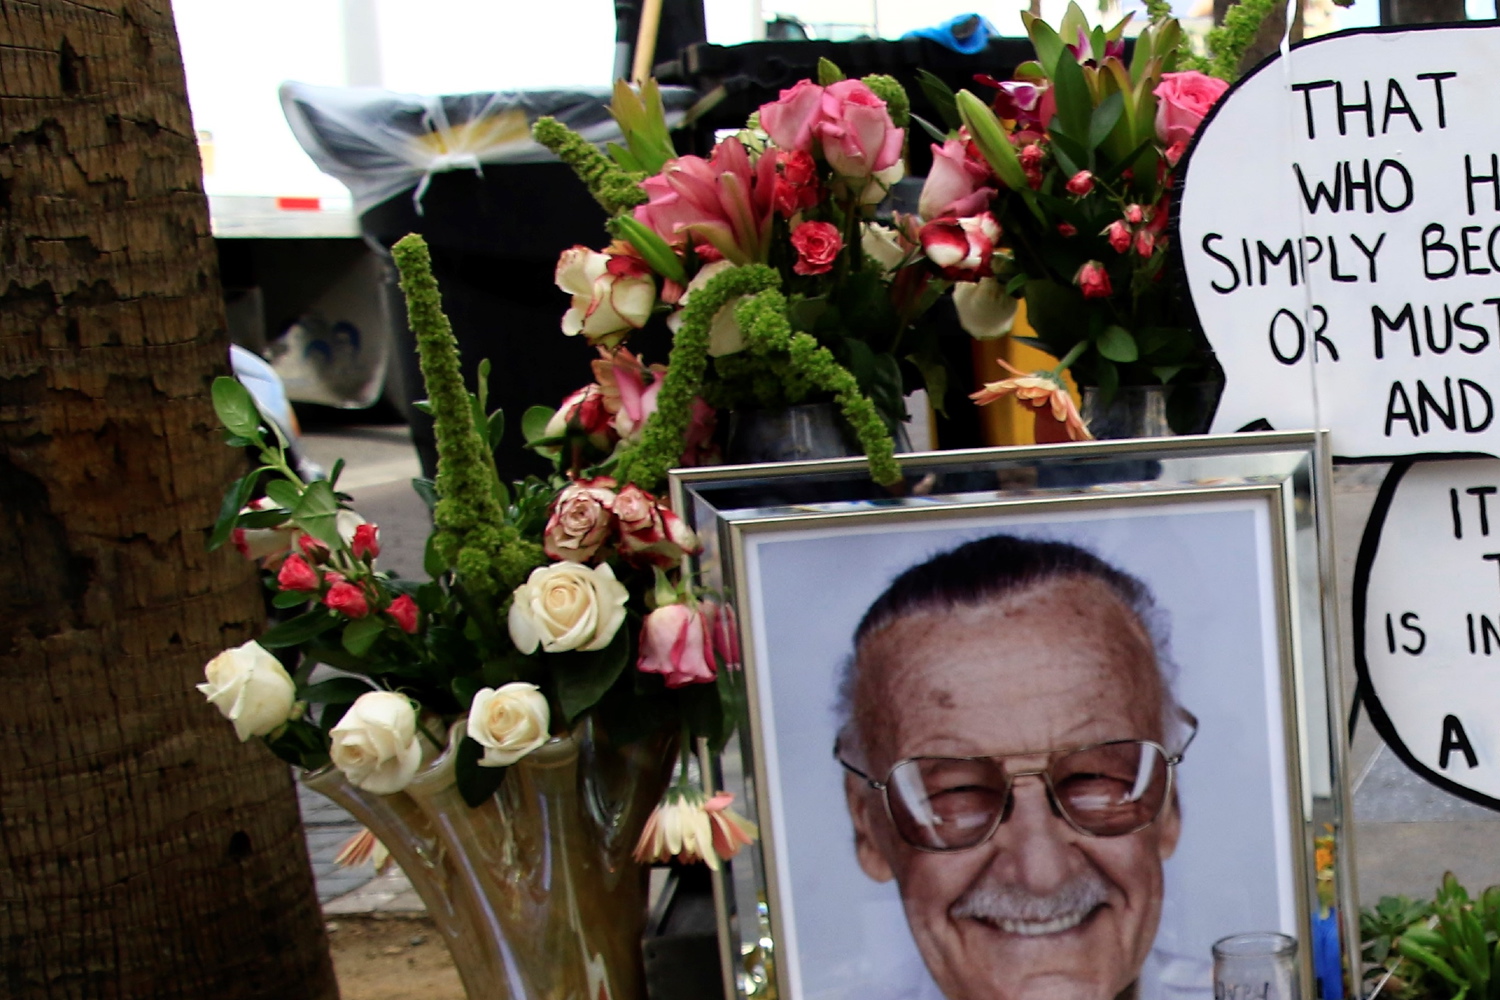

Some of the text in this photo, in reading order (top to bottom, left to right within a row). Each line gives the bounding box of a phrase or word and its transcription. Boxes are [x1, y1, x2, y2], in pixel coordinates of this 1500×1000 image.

[1292, 72, 1456, 139] THAT
[1293, 159, 1413, 214] WHO
[1202, 233, 1385, 294] SIMPLY
[1269, 305, 1339, 365] OR
[1385, 377, 1493, 436] AND
[1450, 486, 1497, 539] IT
[1386, 612, 1425, 655] IS
[1438, 714, 1478, 769] A
